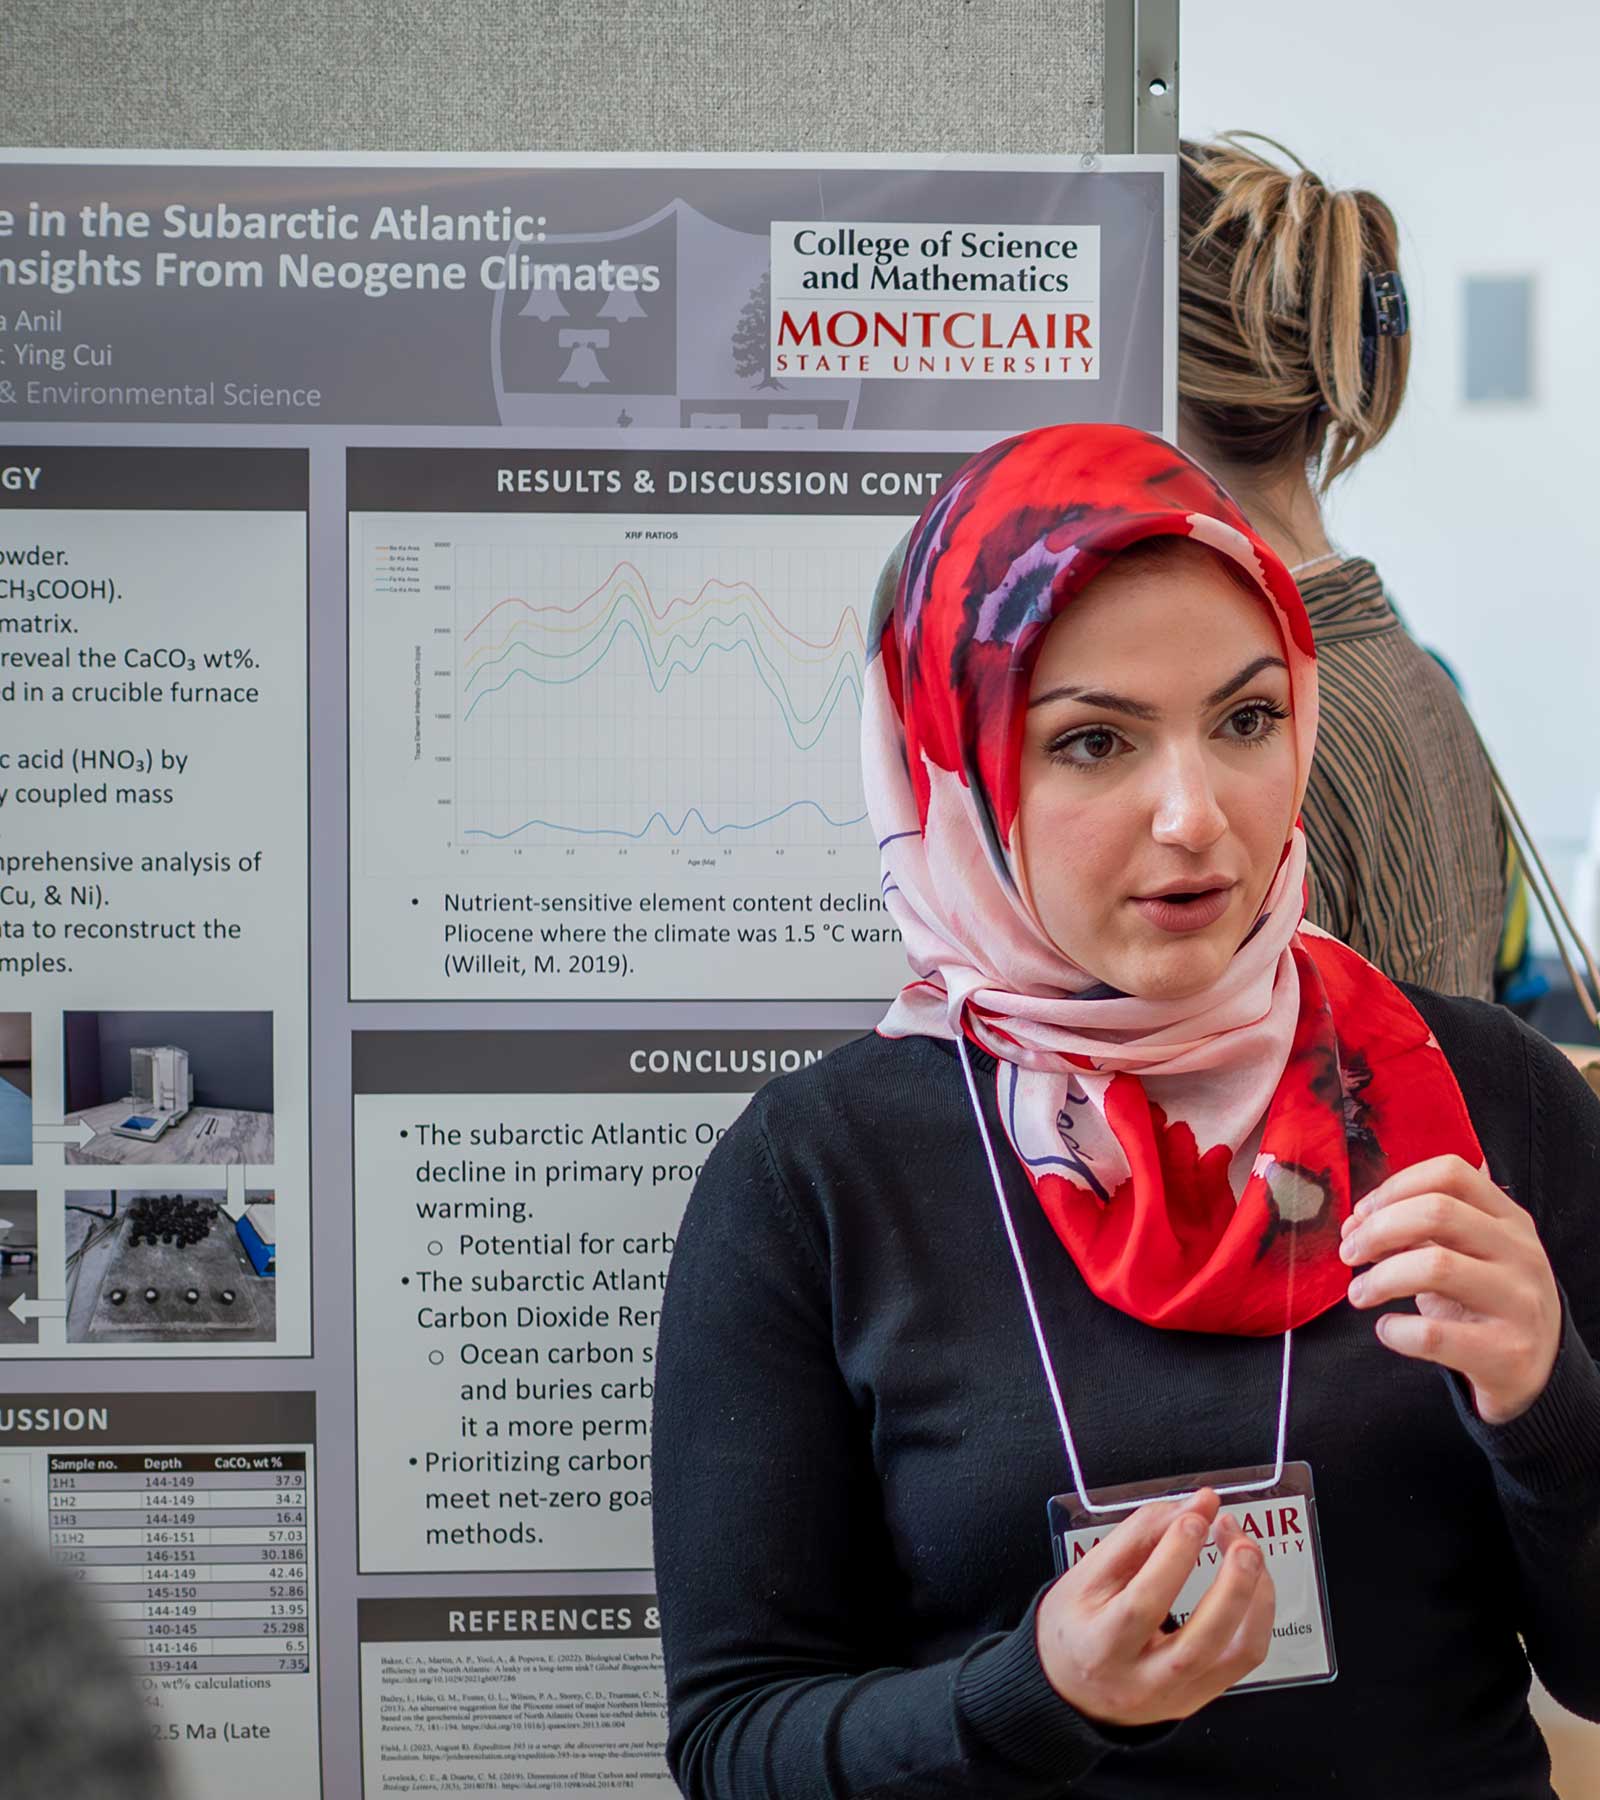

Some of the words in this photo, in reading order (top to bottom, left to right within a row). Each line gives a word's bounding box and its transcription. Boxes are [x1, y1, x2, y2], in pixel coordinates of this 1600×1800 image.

[29, 202, 65, 236] in
[80, 202, 150, 237] the
[164, 203, 358, 240] Subarctic
[371, 205, 546, 244] Atlantic:
[793, 229, 910, 265] College
[921, 231, 952, 257] of
[962, 232, 1077, 258] Science
[157, 253, 262, 287] From
[280, 254, 466, 297] Neogene
[480, 255, 660, 293] Climates
[803, 263, 858, 289] and
[870, 264, 1069, 293] Mathematics
[15, 310, 61, 331] Anil
[776, 310, 1094, 350] MONTCLAIR
[14, 344, 65, 370] Ying
[74, 344, 111, 366] Cui
[777, 355, 868, 371] STATE
[893, 355, 1095, 374] UNIVERSITY
[0, 380, 16, 403] &
[28, 382, 214, 406] Environmental
[223, 383, 322, 409] Science
[498, 470, 621, 492] RESULTS
[634, 470, 655, 493] &
[669, 471, 847, 494] DISCUSSION
[0, 614, 77, 633] matrix.
[2, 647, 69, 667] reveal
[78, 648, 116, 667] the
[204, 649, 259, 668] wt%.
[24, 682, 43, 701] in
[52, 687, 63, 701] a
[72, 682, 162, 702] crucible
[171, 682, 258, 702] furnace
[18, 749, 63, 769] acid
[162, 749, 187, 774] by
[16, 783, 106, 807] coupled
[117, 789, 173, 803] mass
[141, 851, 230, 876] analysis
[239, 851, 262, 871] of
[0, 886, 35, 908] Cu,
[45, 885, 62, 905] &
[72, 885, 108, 909] Ni).
[445, 894, 632, 911] Nutrient-sensitive
[640, 893, 725, 911] element
[733, 896, 812, 911] content
[32, 921, 56, 938] to
[65, 921, 195, 938] reconstruct
[203, 919, 240, 938] the
[445, 924, 533, 942] Pliocene
[541, 924, 606, 942] where
[614, 924, 647, 942] the
[655, 924, 730, 942] climate
[738, 929, 776, 942] was
[786, 925, 815, 942] 1.5
[445, 954, 525, 977] (Willeit,
[535, 956, 560, 973] M.
[569, 954, 633, 977] 2019).
[415, 1124, 461, 1145] The
[471, 1123, 583, 1145] subarctic
[592, 1123, 686, 1144] Atlantic
[417, 1160, 505, 1182] decline
[516, 1161, 535, 1181] in
[547, 1161, 643, 1186] primary
[417, 1197, 532, 1223] warming.
[461, 1233, 570, 1255] Potential
[579, 1233, 614, 1254] for
[416, 1270, 462, 1292] The
[472, 1270, 584, 1291] subarctic
[418, 1306, 506, 1328] Carbon
[518, 1305, 609, 1327] Dioxide
[461, 1344, 538, 1364] Ocean
[549, 1342, 633, 1363] carbon
[461, 1378, 506, 1400] and
[517, 1378, 592, 1399] buries
[462, 1416, 477, 1437] it
[486, 1421, 498, 1436] a
[509, 1421, 573, 1436] more
[51, 1459, 96, 1471] Sample
[98, 1460, 118, 1470] no.
[144, 1458, 182, 1470] Depth
[427, 1451, 559, 1476] Prioritizing
[53, 1478, 75, 1488] 1H1
[146, 1476, 194, 1488] 144-149
[275, 1475, 302, 1486] 37.9
[53, 1497, 76, 1506] 1H2
[146, 1495, 194, 1506] 144-149
[275, 1494, 302, 1504] 34.2
[427, 1490, 490, 1508] meet
[500, 1489, 600, 1508] net-zero
[54, 1515, 76, 1524] 1H3
[146, 1514, 195, 1524] 144-149
[277, 1512, 302, 1523] 16.4
[147, 1532, 195, 1544] 146-151
[269, 1531, 302, 1542] 57.03
[427, 1522, 542, 1544] methods.
[147, 1550, 195, 1562] 146-151
[148, 1569, 196, 1580] 144-149
[269, 1568, 304, 1578] 42.46
[148, 1588, 196, 1598] 145-150
[270, 1586, 304, 1597] 52.86
[148, 1606, 196, 1616] 144-149
[270, 1604, 304, 1615] 13.95
[449, 1608, 631, 1632] REFERENCES
[644, 1607, 661, 1629] &
[263, 1622, 304, 1634] 25.298
[1272, 1622, 1312, 1638] tudies
[286, 1641, 304, 1652] 6.5
[279, 1659, 304, 1670] 7.35
[195, 1677, 271, 1690] calculations
[187, 1724, 216, 1739] Ma
[224, 1722, 270, 1742] (Late
